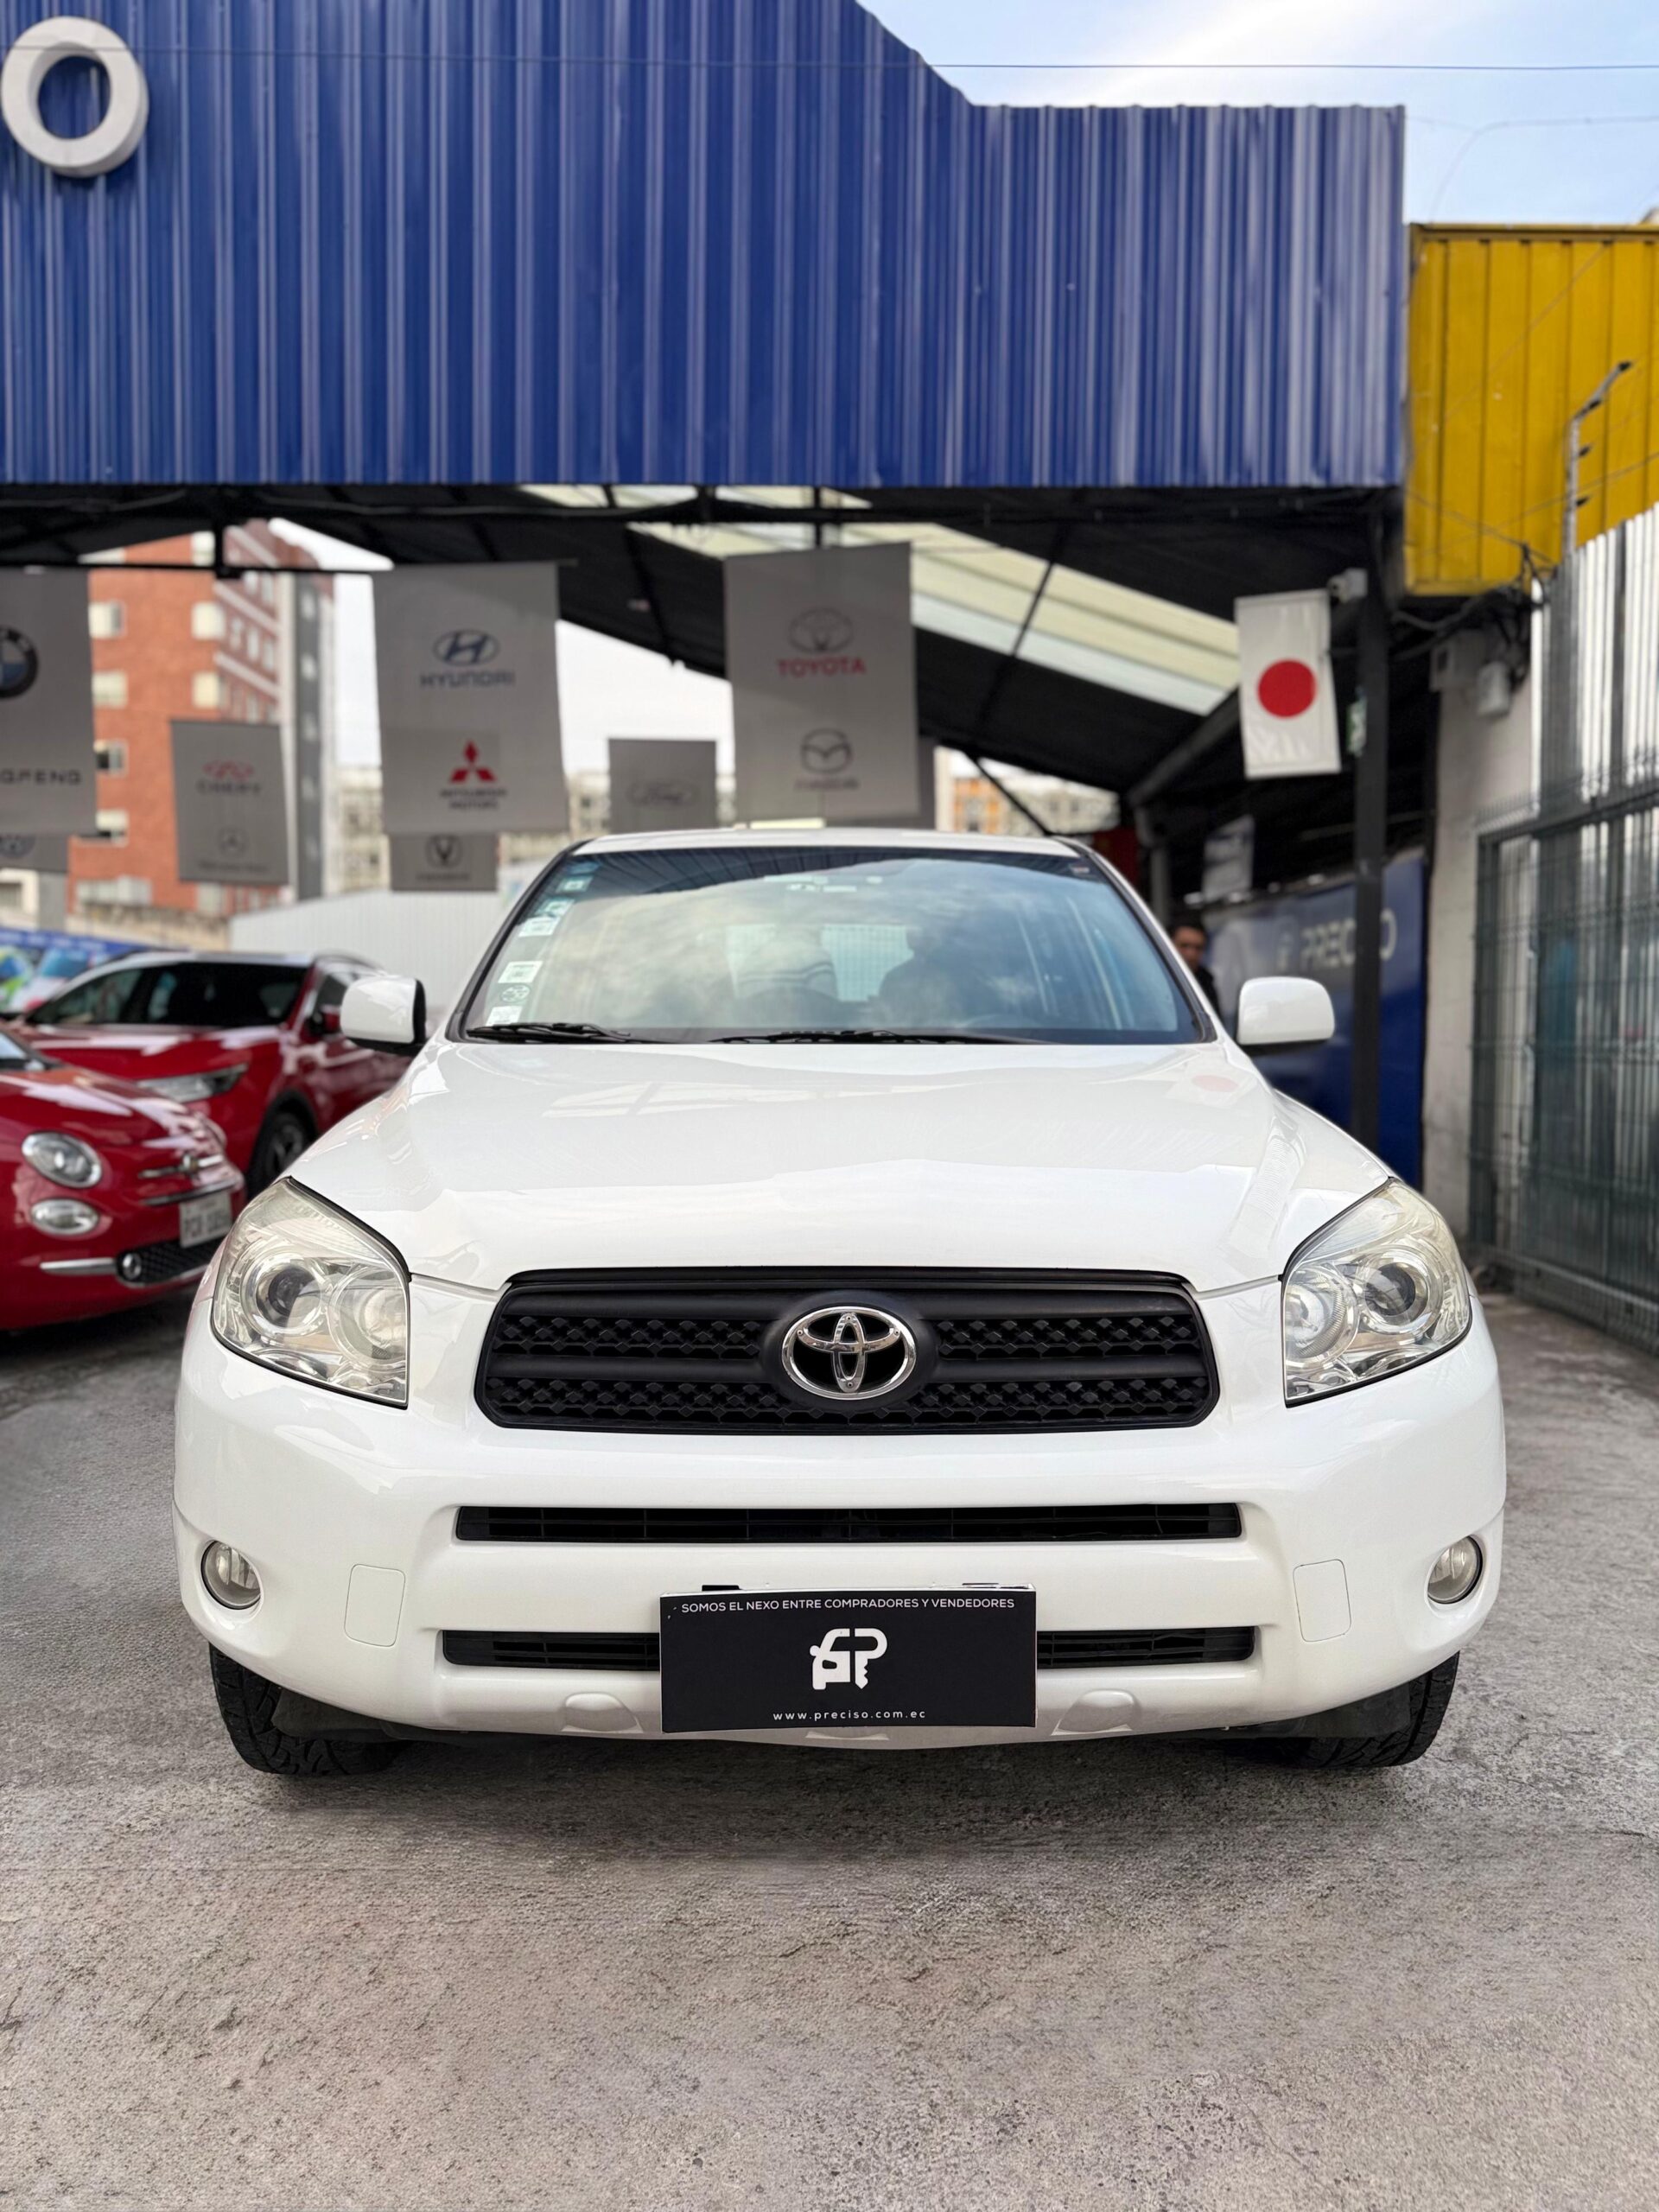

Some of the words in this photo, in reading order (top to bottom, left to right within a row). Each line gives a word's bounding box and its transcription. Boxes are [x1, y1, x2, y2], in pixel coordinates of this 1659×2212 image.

[777, 656, 867, 677] TOYOTA
[420, 669, 515, 688] HYUNDAI
[1300, 908, 1397, 972] PRECO
[681, 1602, 727, 1613] SOMOS
[729, 1601, 744, 1611] EL
[746, 1600, 779, 1611] NEXO
[782, 1599, 822, 1609] ENTRE
[824, 1599, 919, 1609] COMPRADORES
[921, 1599, 930, 1607] Y
[931, 1599, 1015, 1608] VENDEDORES
[772, 1710, 926, 1722] www.preciso.com.ec
